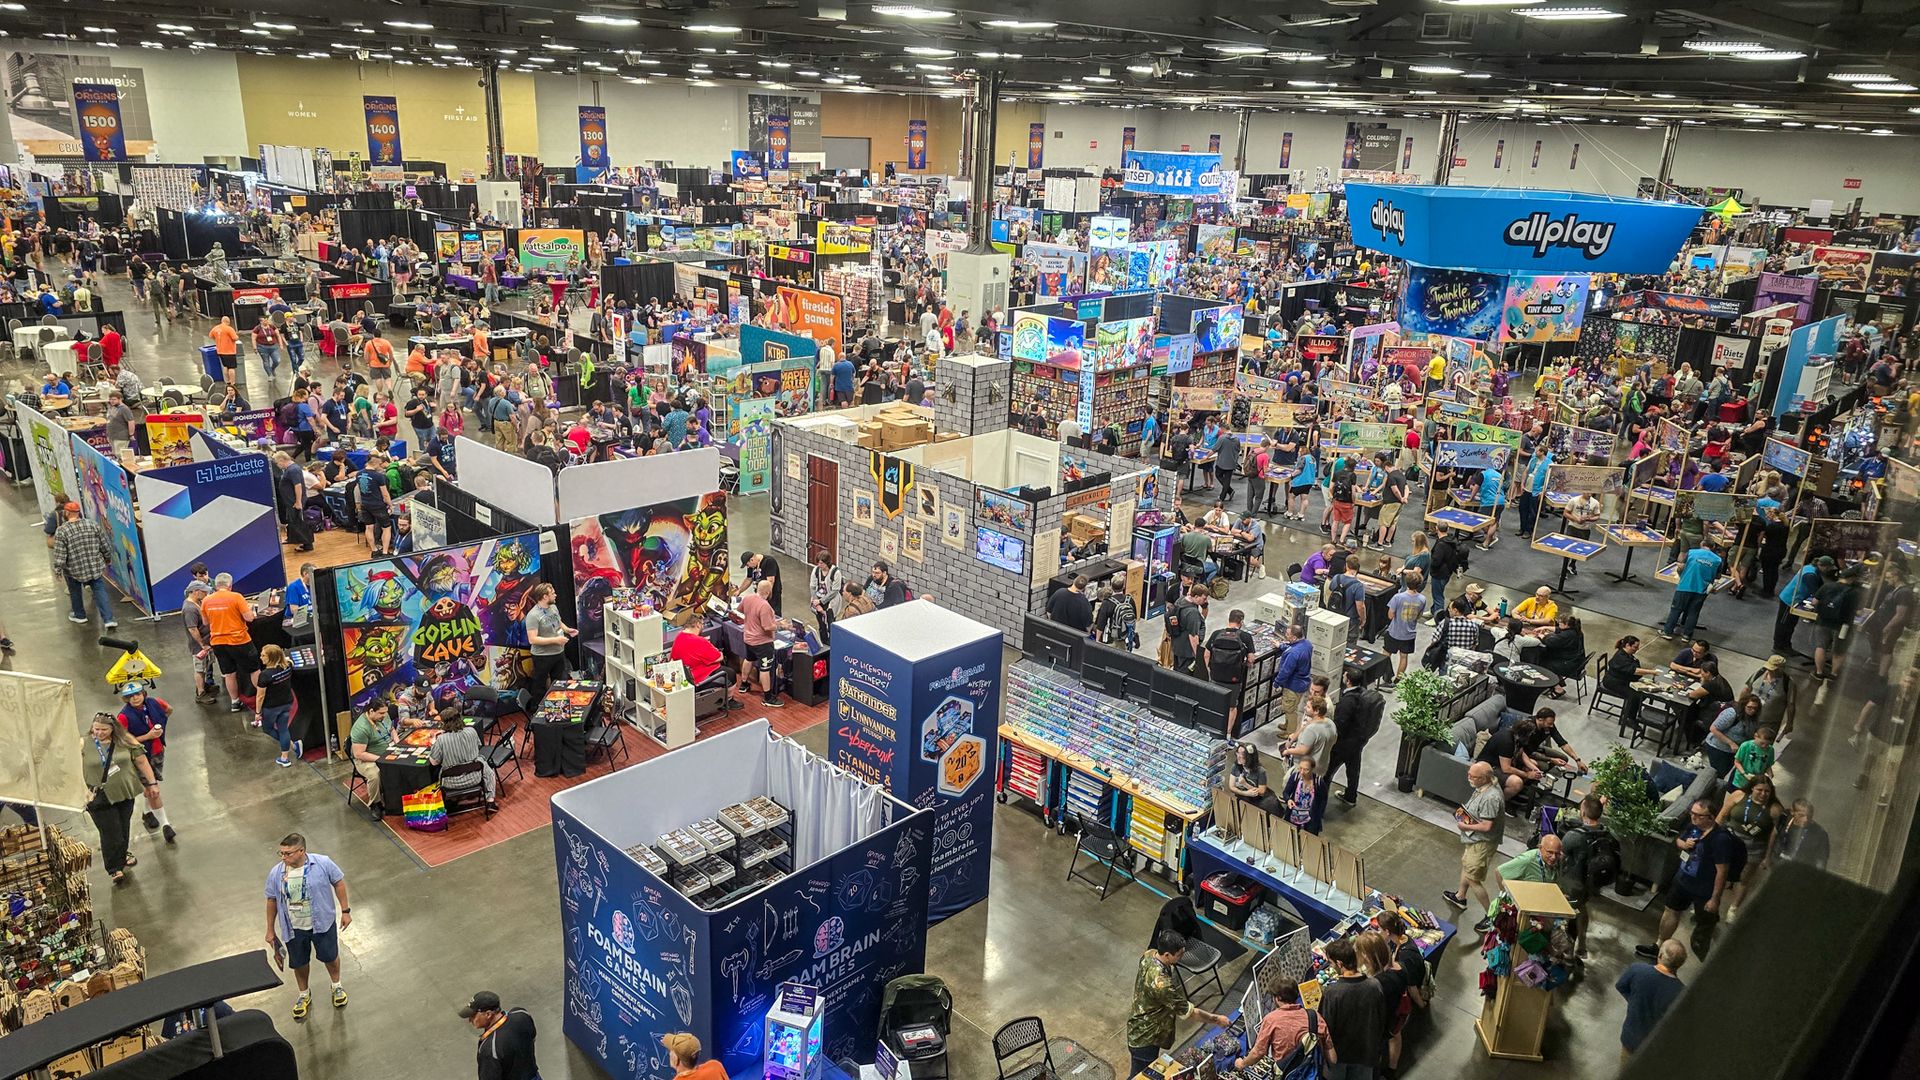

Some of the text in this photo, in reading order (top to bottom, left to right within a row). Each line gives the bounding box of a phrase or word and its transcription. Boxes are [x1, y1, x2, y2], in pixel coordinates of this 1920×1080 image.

[75, 91, 117, 100] ORIGINS
[365, 103, 397, 111] ORIGINS
[83, 116, 116, 128] 1500
[370, 124, 395, 134] 1400
[583, 131, 603, 141] 1300
[770, 137, 786, 146] 1200
[911, 140, 924, 148] 1100
[1843, 179, 1861, 188] EXIT
[1371, 199, 1615, 257] allplay allplay
[1430, 284, 1469, 302] Twinkle
[802, 298, 835, 315] fireside
[1440, 301, 1480, 320] Twinkle
[1527, 305, 1563, 313] TINY GAMES
[805, 313, 834, 327] games
[1311, 339, 1331, 347] ILIAD
[767, 347, 786, 360] KTBG
[1723, 349, 1744, 358] Dietz
[781, 368, 810, 381] MAPLE
[214, 458, 265, 475] hachette
[215, 470, 252, 481] BOARDGAMES
[412, 616, 482, 646] GOBLIN
[421, 636, 475, 662] CAVE
[843, 655, 892, 681] OUR LICENSING
[849, 667, 890, 690] PARTNERS!
[838, 677, 897, 720] PATHFINDER
[862, 726, 883, 741] STUDIOS
[839, 749, 892, 786] CYANIDE &
[955, 754, 966, 771] 20
[940, 813, 950, 822] TO
[951, 803, 969, 816] LEVEL
[848, 885, 858, 897] 20
[872, 890, 878, 900] 6
[829, 928, 881, 970] BRAIN
[587, 921, 667, 998] FOAM BRAIN
[605, 955, 647, 995] GAMES
[815, 959, 855, 989] AMES
[826, 987, 844, 1000] NEXT
[842, 978, 860, 990] GAME
[107, 1038, 137, 1050] WELCOME
